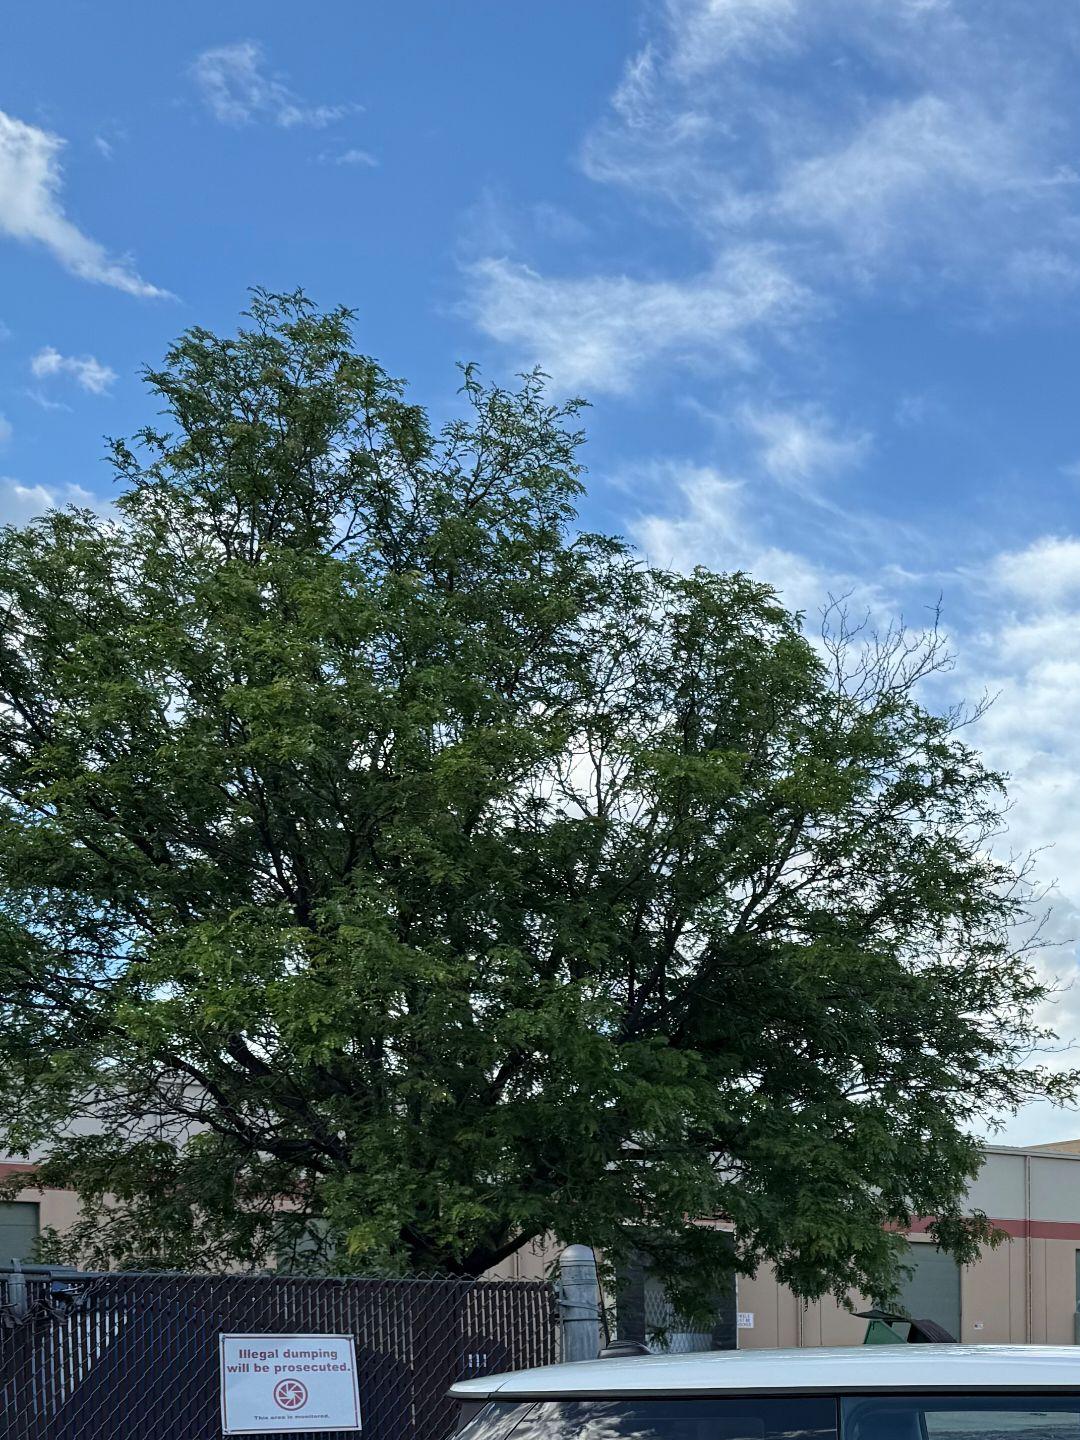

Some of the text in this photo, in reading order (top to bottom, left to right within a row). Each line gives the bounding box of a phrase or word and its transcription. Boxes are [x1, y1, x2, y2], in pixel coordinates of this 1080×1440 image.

[239, 1348, 338, 1360] Illegal dumping
[226, 1362, 351, 1374] will be prosecuted.
